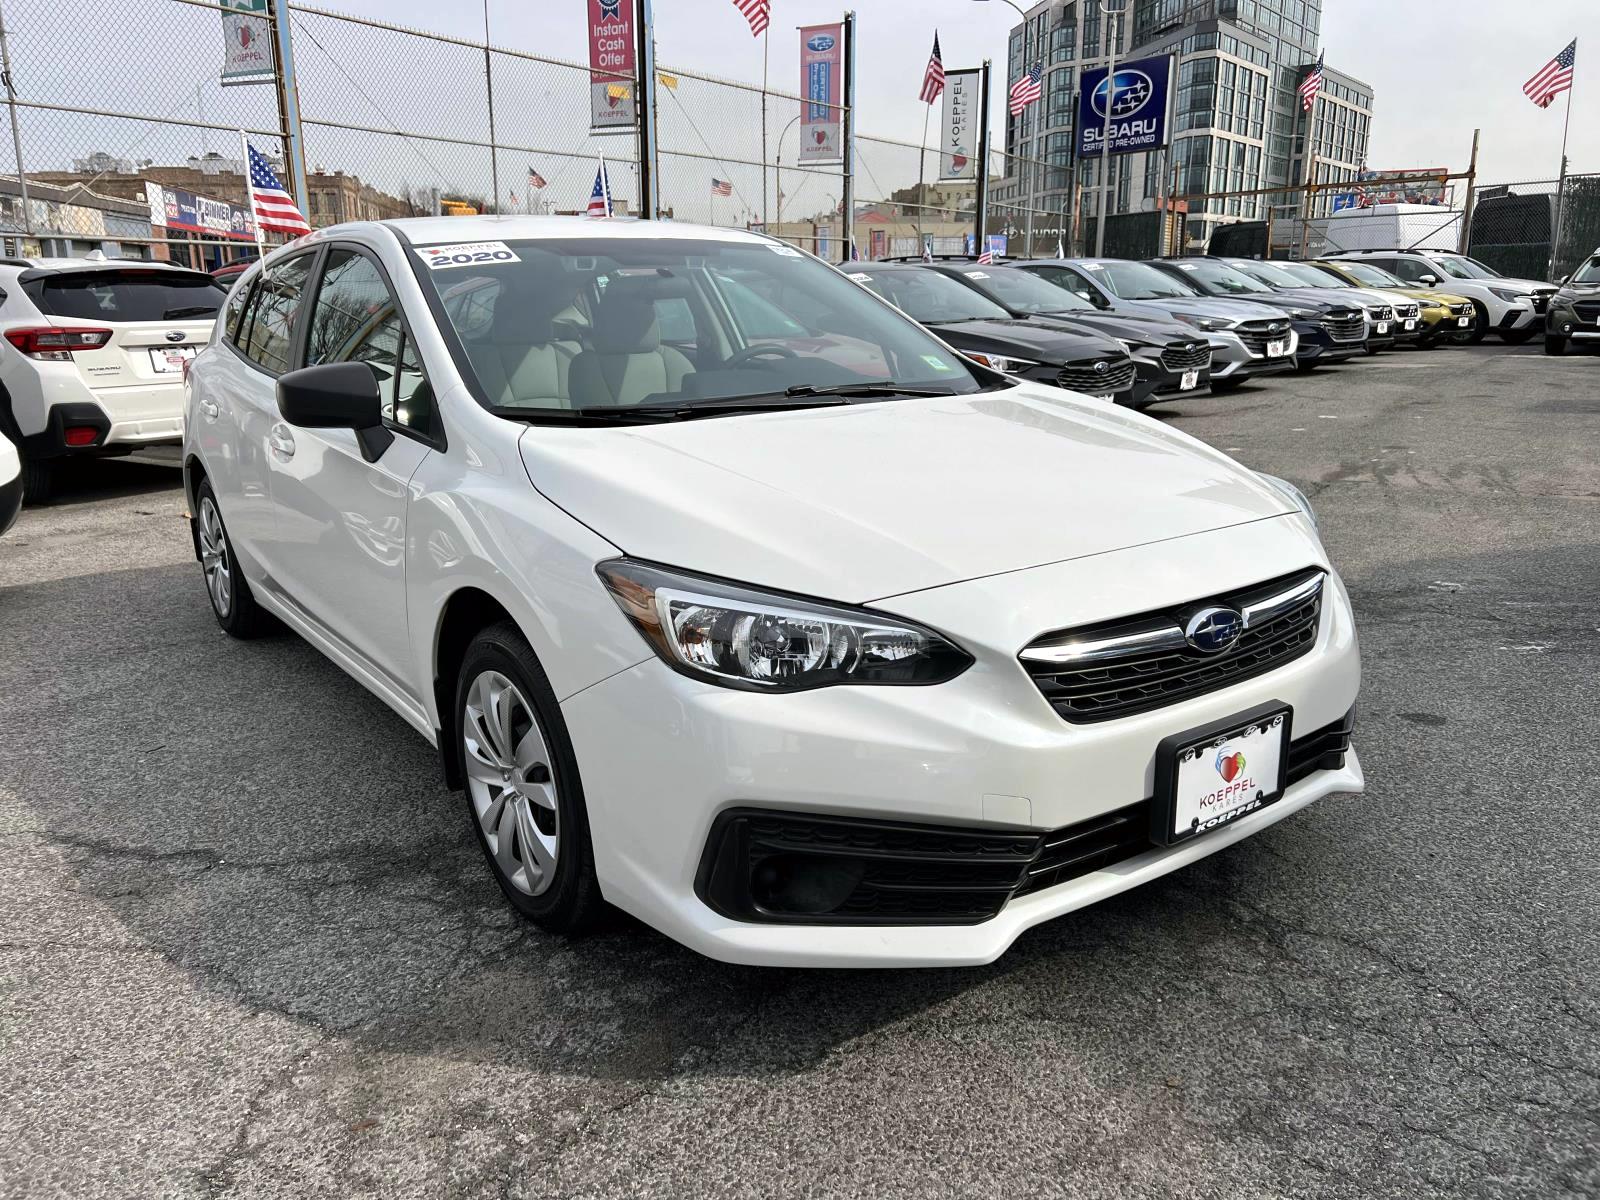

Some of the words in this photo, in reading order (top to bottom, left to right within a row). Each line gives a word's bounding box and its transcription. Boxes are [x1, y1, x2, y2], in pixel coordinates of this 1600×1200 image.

[593, 21, 628, 37] Instant
[598, 39, 625, 51] Cash
[599, 53, 625, 66] Offer
[951, 76, 963, 147] KOEPPEL
[1083, 118, 1157, 142] SUBARU
[1082, 140, 1114, 151] CERTIFD
[1115, 134, 1155, 147] PRE-OWNED
[430, 251, 513, 266] 2020
[1199, 777, 1256, 809] KOEPPEL
[1212, 793, 1244, 812] KARES
[1195, 799, 1262, 833] KOEPPEL
